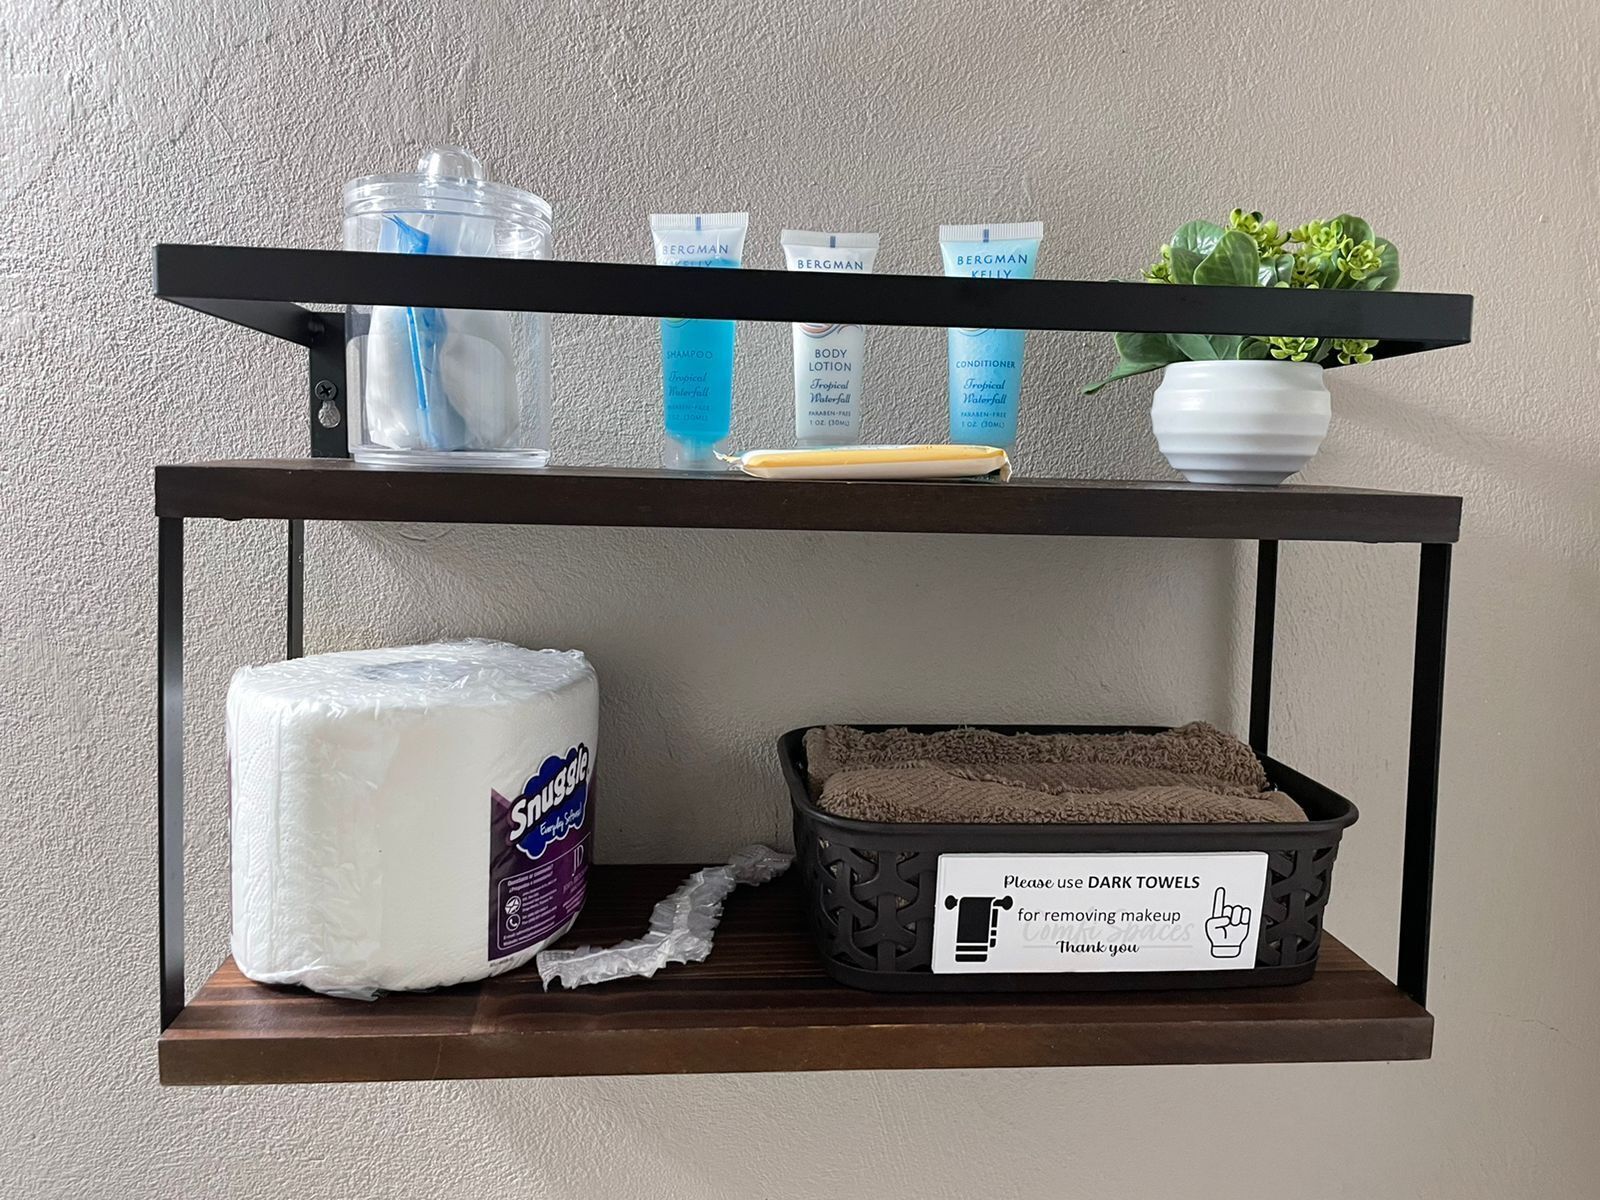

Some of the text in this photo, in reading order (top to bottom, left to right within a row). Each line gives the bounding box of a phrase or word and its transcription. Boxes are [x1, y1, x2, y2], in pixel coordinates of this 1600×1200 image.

[662, 245, 728, 255] BERGMAN
[797, 259, 863, 270] BERGMAN
[957, 254, 1028, 265] BERGMAN
[667, 350, 713, 359] SHAMPOO
[815, 348, 847, 359] BODY
[809, 361, 852, 372] LOTION
[955, 360, 1016, 369] CONDITIONER
[669, 369, 708, 384] Tropical
[810, 378, 849, 391] Tropical
[963, 378, 1006, 391] Tropical
[669, 385, 710, 398] Waterfall
[810, 392, 851, 404] Waterfall
[963, 393, 1007, 405] Waterfall
[509, 746, 588, 841] Snuggle
[1004, 875, 1200, 889] Please use DARK TOWELS
[1018, 908, 1181, 925] for removing makeup
[1056, 941, 1139, 957] Thank you
